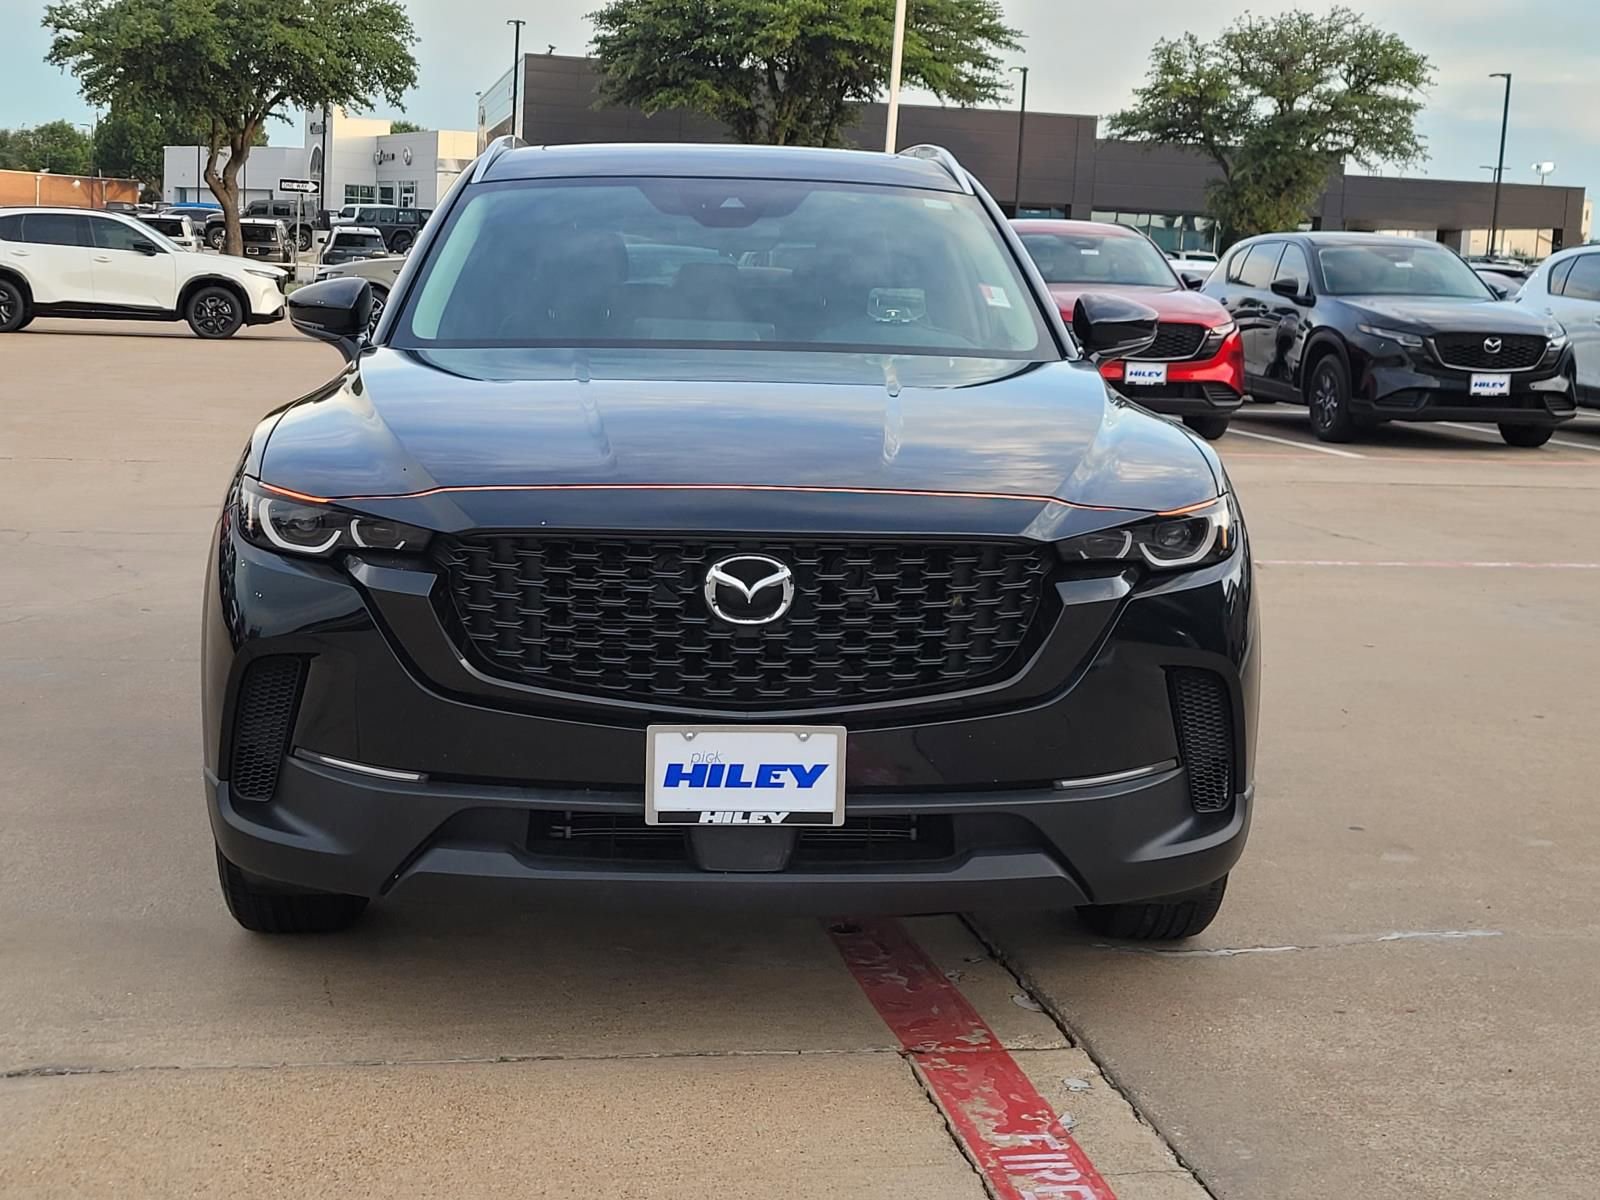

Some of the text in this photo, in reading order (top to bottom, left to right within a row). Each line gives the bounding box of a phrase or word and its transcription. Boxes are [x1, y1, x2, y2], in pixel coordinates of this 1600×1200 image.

[1129, 370, 1162, 378] HILEY
[690, 750, 724, 766] pick
[663, 763, 830, 788] HILEY
[698, 811, 790, 824] HILEY
